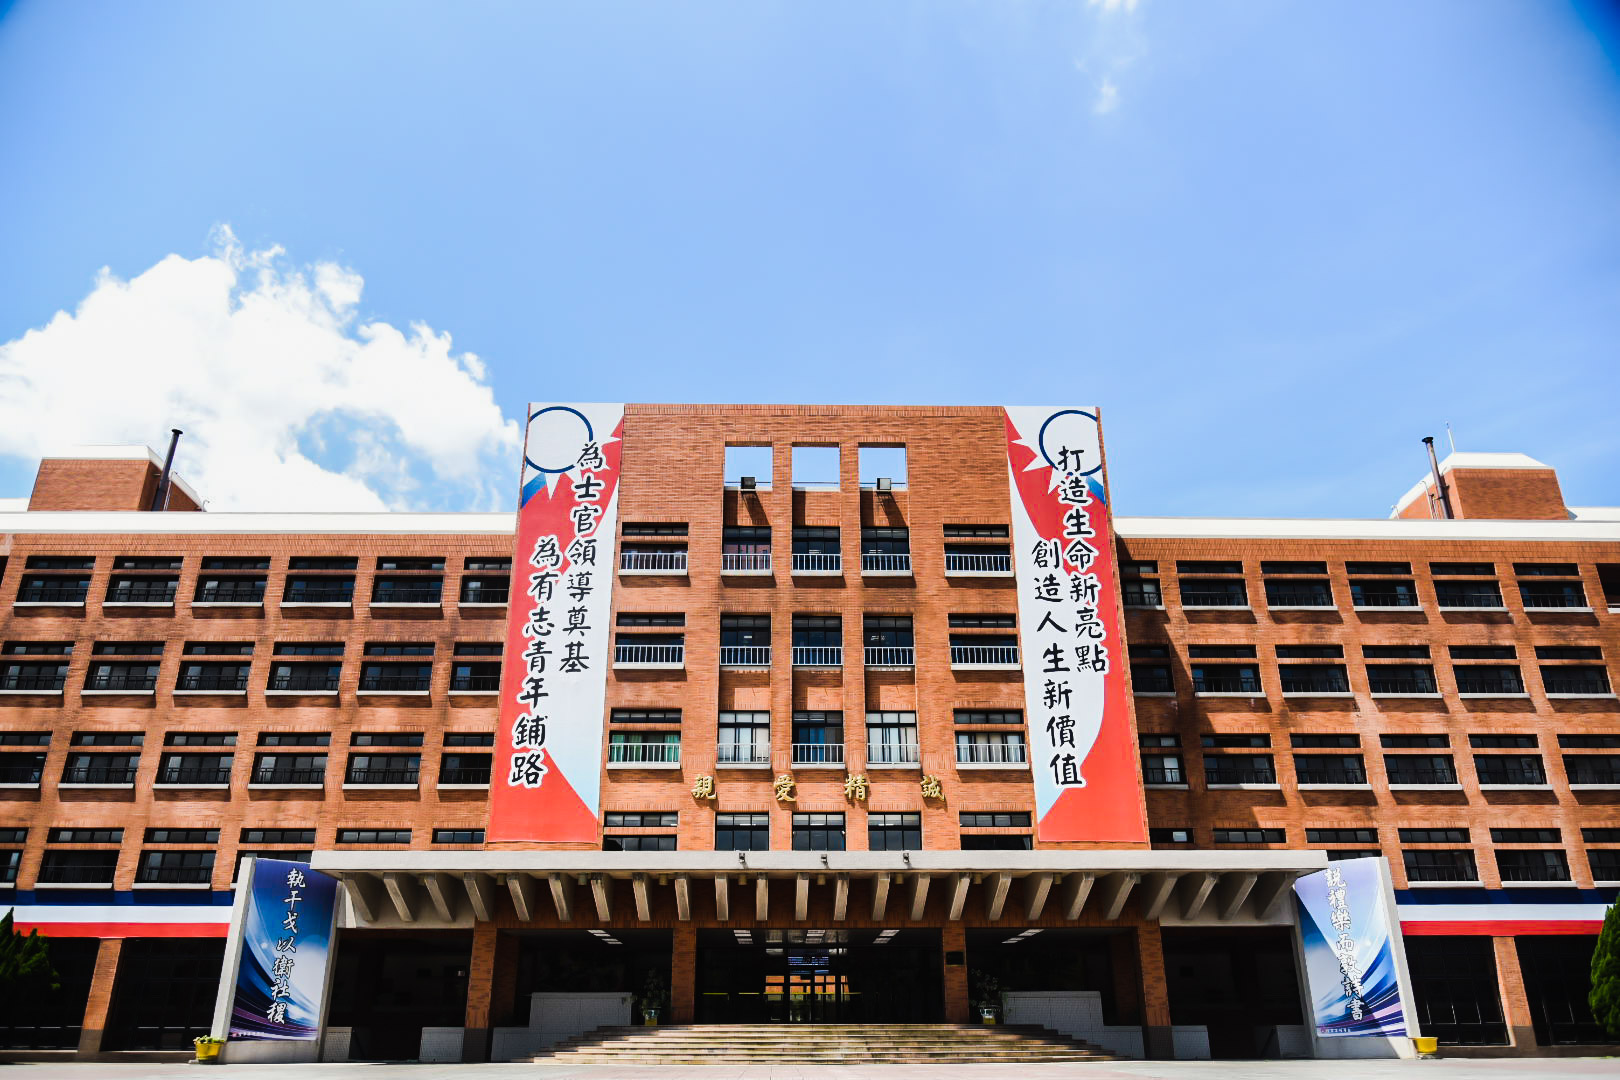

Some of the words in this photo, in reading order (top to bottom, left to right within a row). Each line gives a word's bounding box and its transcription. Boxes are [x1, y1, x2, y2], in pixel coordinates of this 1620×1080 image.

[511, 537, 560, 785] 為有志青年鋪路
[559, 442, 603, 673] 為士官領導奠基
[1031, 540, 1082, 785] 創造人生新價值
[1057, 446, 1106, 673] 打造生命新亮點
[691, 773, 945, 801] 親愛精誠
[266, 868, 306, 1024] 執干戈以衛社稷
